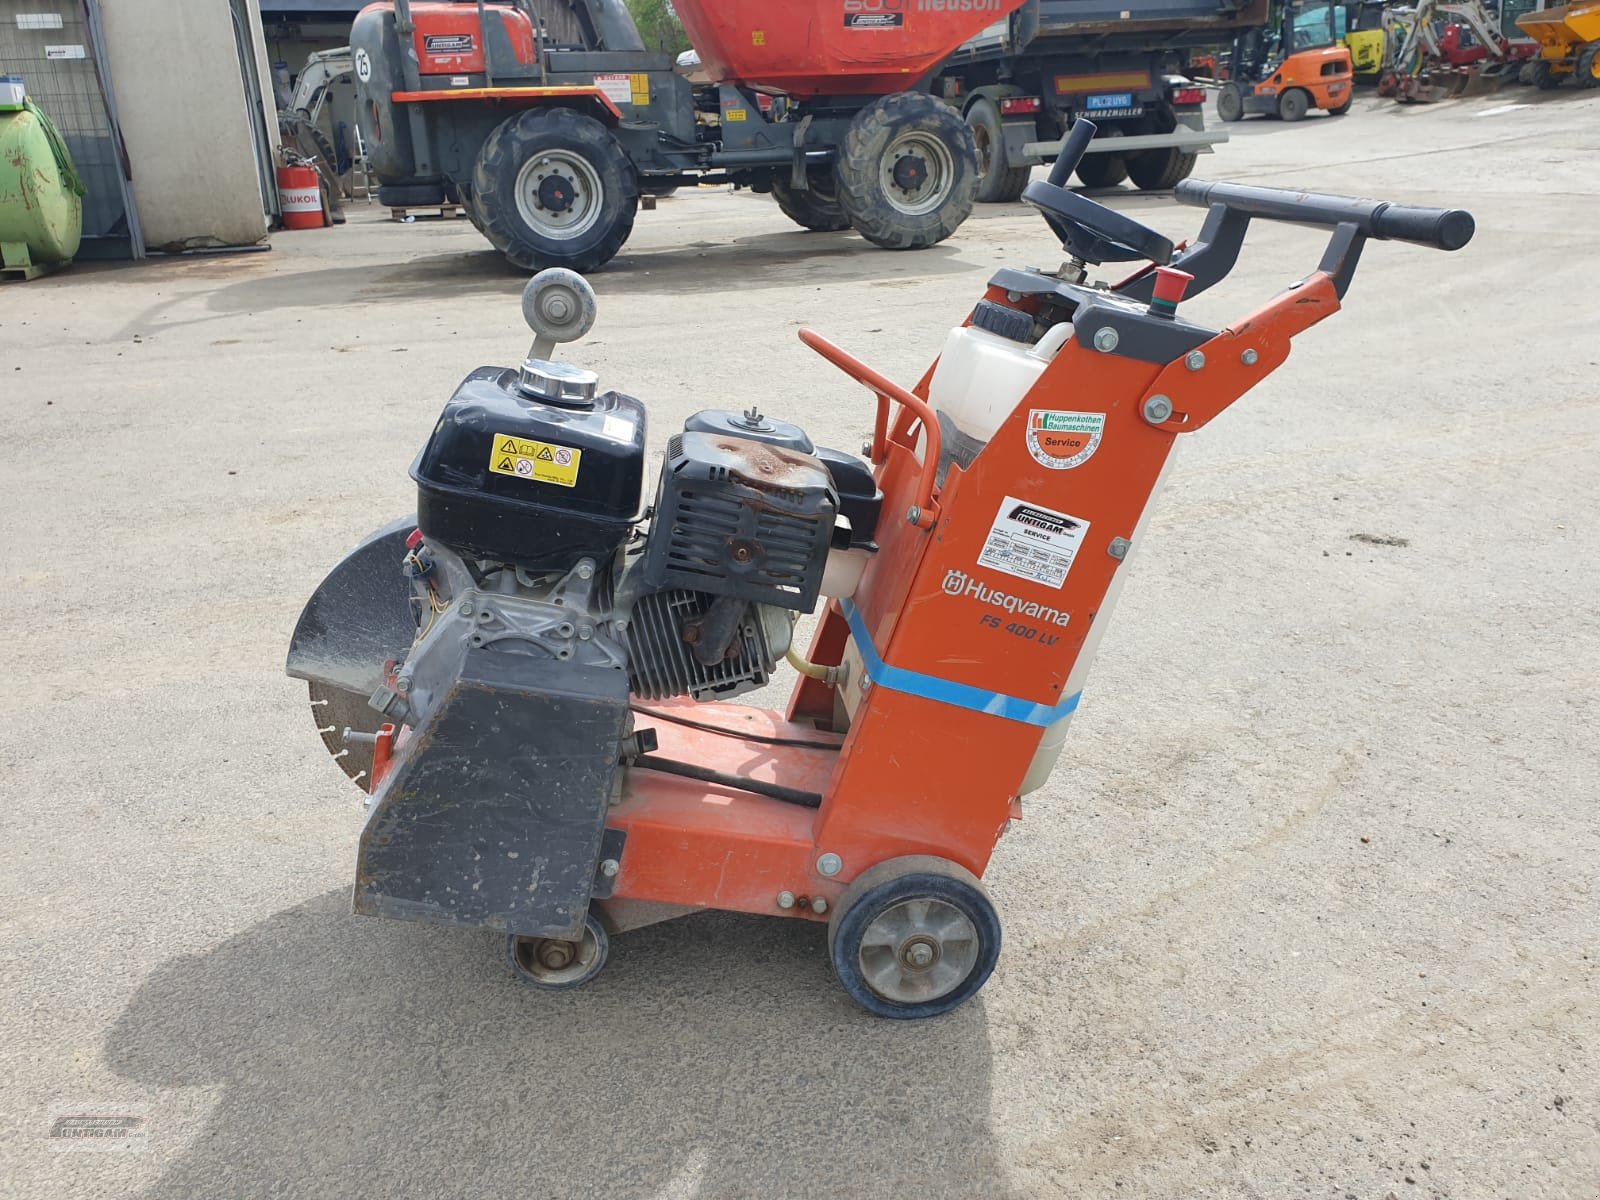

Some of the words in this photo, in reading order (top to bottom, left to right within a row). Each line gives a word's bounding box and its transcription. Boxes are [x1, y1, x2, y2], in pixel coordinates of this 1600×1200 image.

[357, 53, 369, 76] 25
[286, 195, 317, 204] LUKOIL
[1048, 413, 1102, 424] Huppenkothen
[1047, 422, 1100, 432] Baumaschinen
[1045, 437, 1081, 447] Service
[1017, 514, 1064, 534] UNTIGAM
[1023, 528, 1051, 541] SERVICE
[964, 578, 1071, 627] Husqvarna
[979, 614, 1001, 629] FS
[1005, 622, 1037, 640] 400
[1038, 632, 1060, 646] LV
